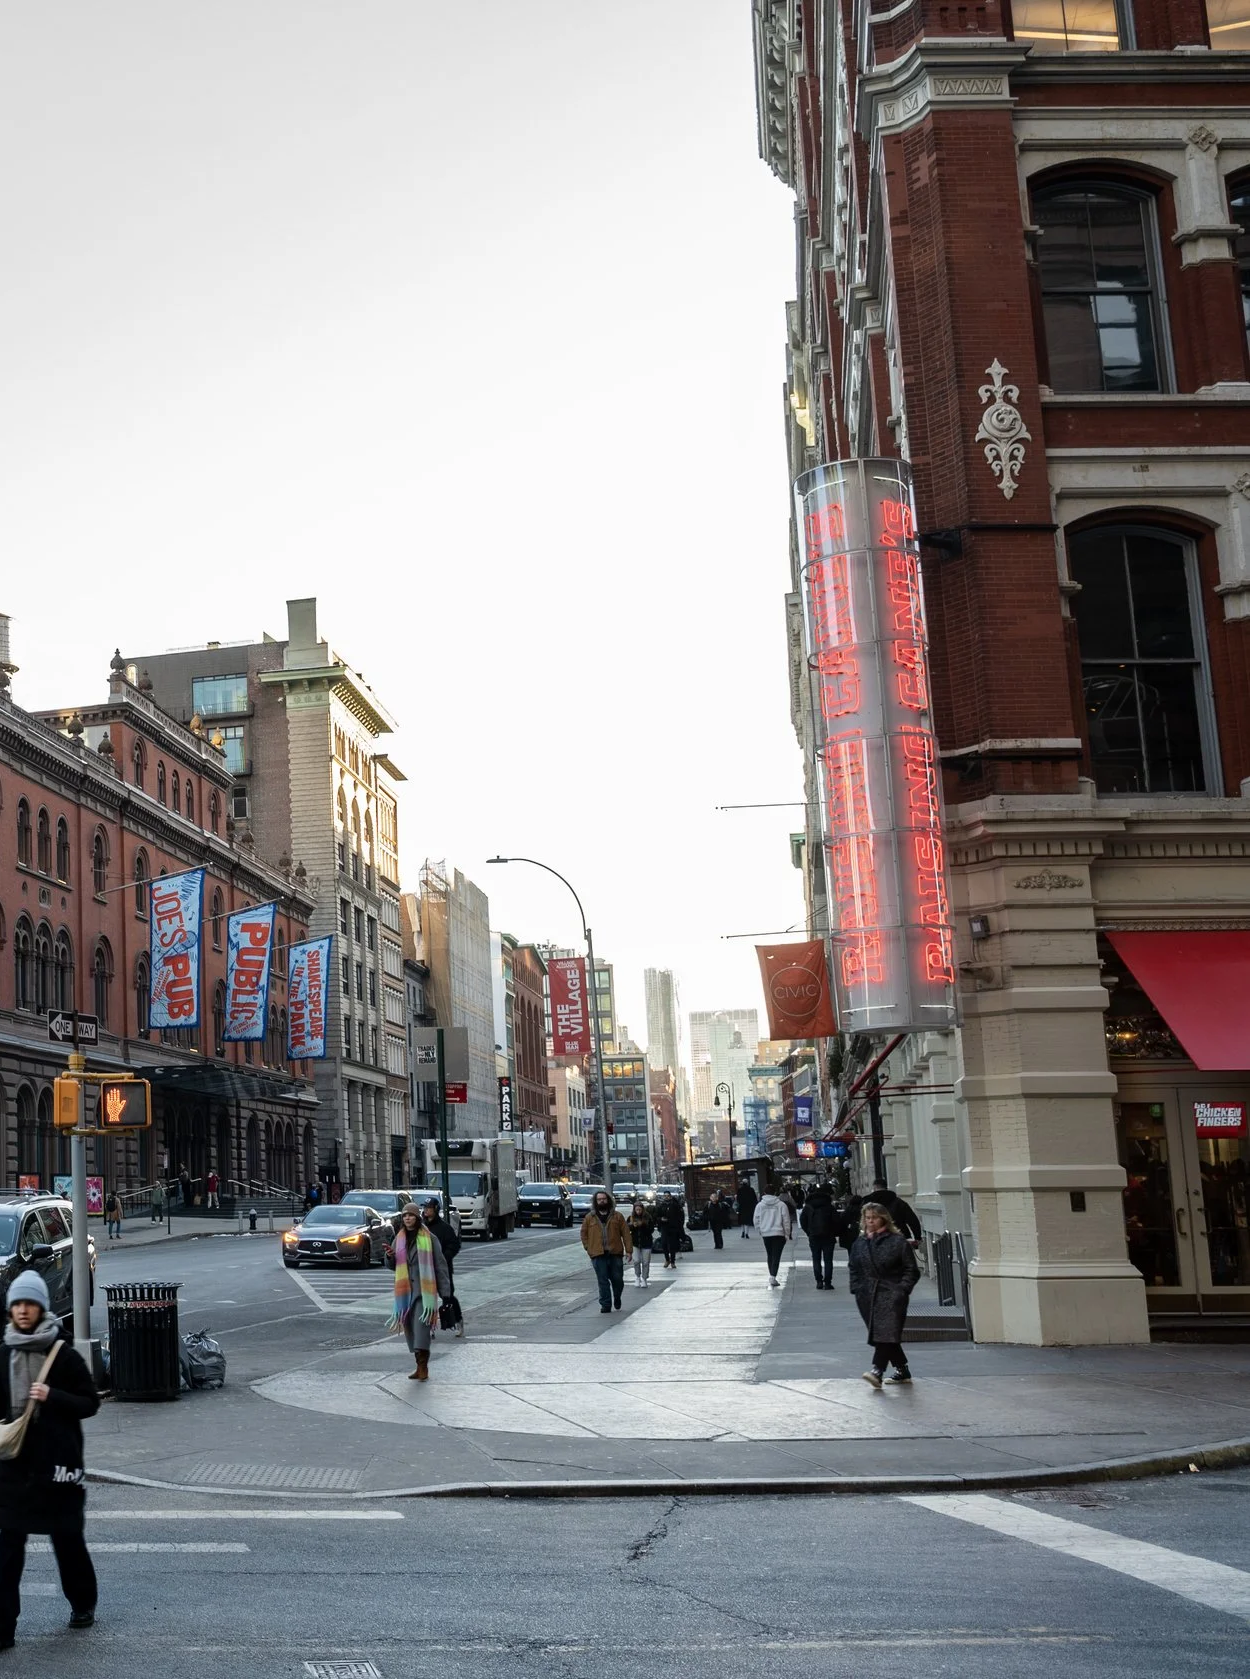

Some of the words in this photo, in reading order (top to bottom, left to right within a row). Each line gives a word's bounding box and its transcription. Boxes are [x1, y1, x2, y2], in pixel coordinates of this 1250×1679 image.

[882, 499, 929, 710] CANE'S
[900, 725, 955, 983] RAISING
[151, 886, 188, 948] JOE'S
[163, 951, 195, 1020] PUB
[230, 922, 270, 1021] PUBLIC
[290, 980, 300, 999] THE
[294, 966, 305, 979] IN
[774, 984, 817, 999] CIVIC
[307, 949, 324, 1040] SHAKESPEARE
[567, 969, 584, 1035] VILLAGE
[55, 1021, 71, 1034] ONE
[78, 1023, 94, 1037] WAY
[290, 999, 306, 1049] PARK
[556, 1004, 571, 1036] THE
[501, 1086, 510, 1122] PARK
[1195, 1107, 1242, 1118] CHICKEN
[1197, 1117, 1242, 1127] FINGERS
